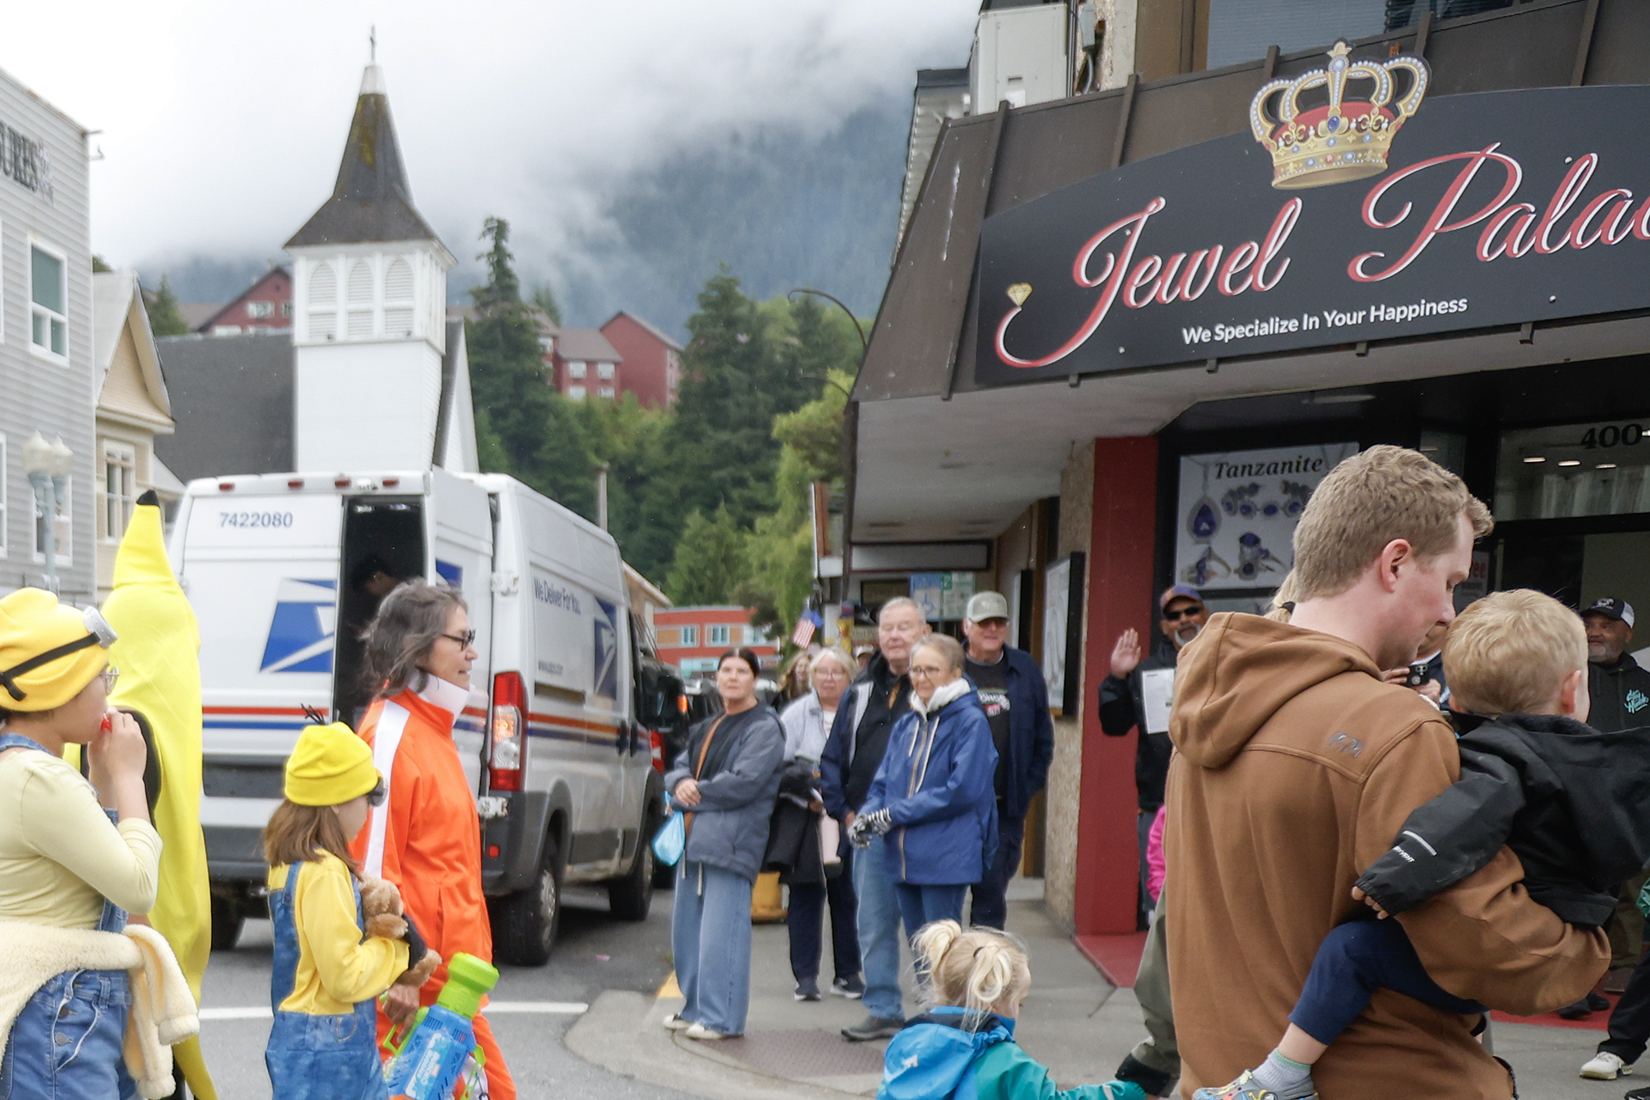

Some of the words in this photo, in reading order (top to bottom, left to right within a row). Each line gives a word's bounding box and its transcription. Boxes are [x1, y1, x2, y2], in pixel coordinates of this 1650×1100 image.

[995, 196, 1302, 368] Jewel
[1182, 326, 1211, 345] We
[1213, 317, 1299, 343] Specialize
[1302, 313, 1320, 332] In
[1324, 308, 1367, 329] Your
[1369, 297, 1469, 323] Happiness
[1579, 423, 1643, 450] 400
[1215, 455, 1323, 480] Tanzanite
[219, 510, 294, 529] 7422080
